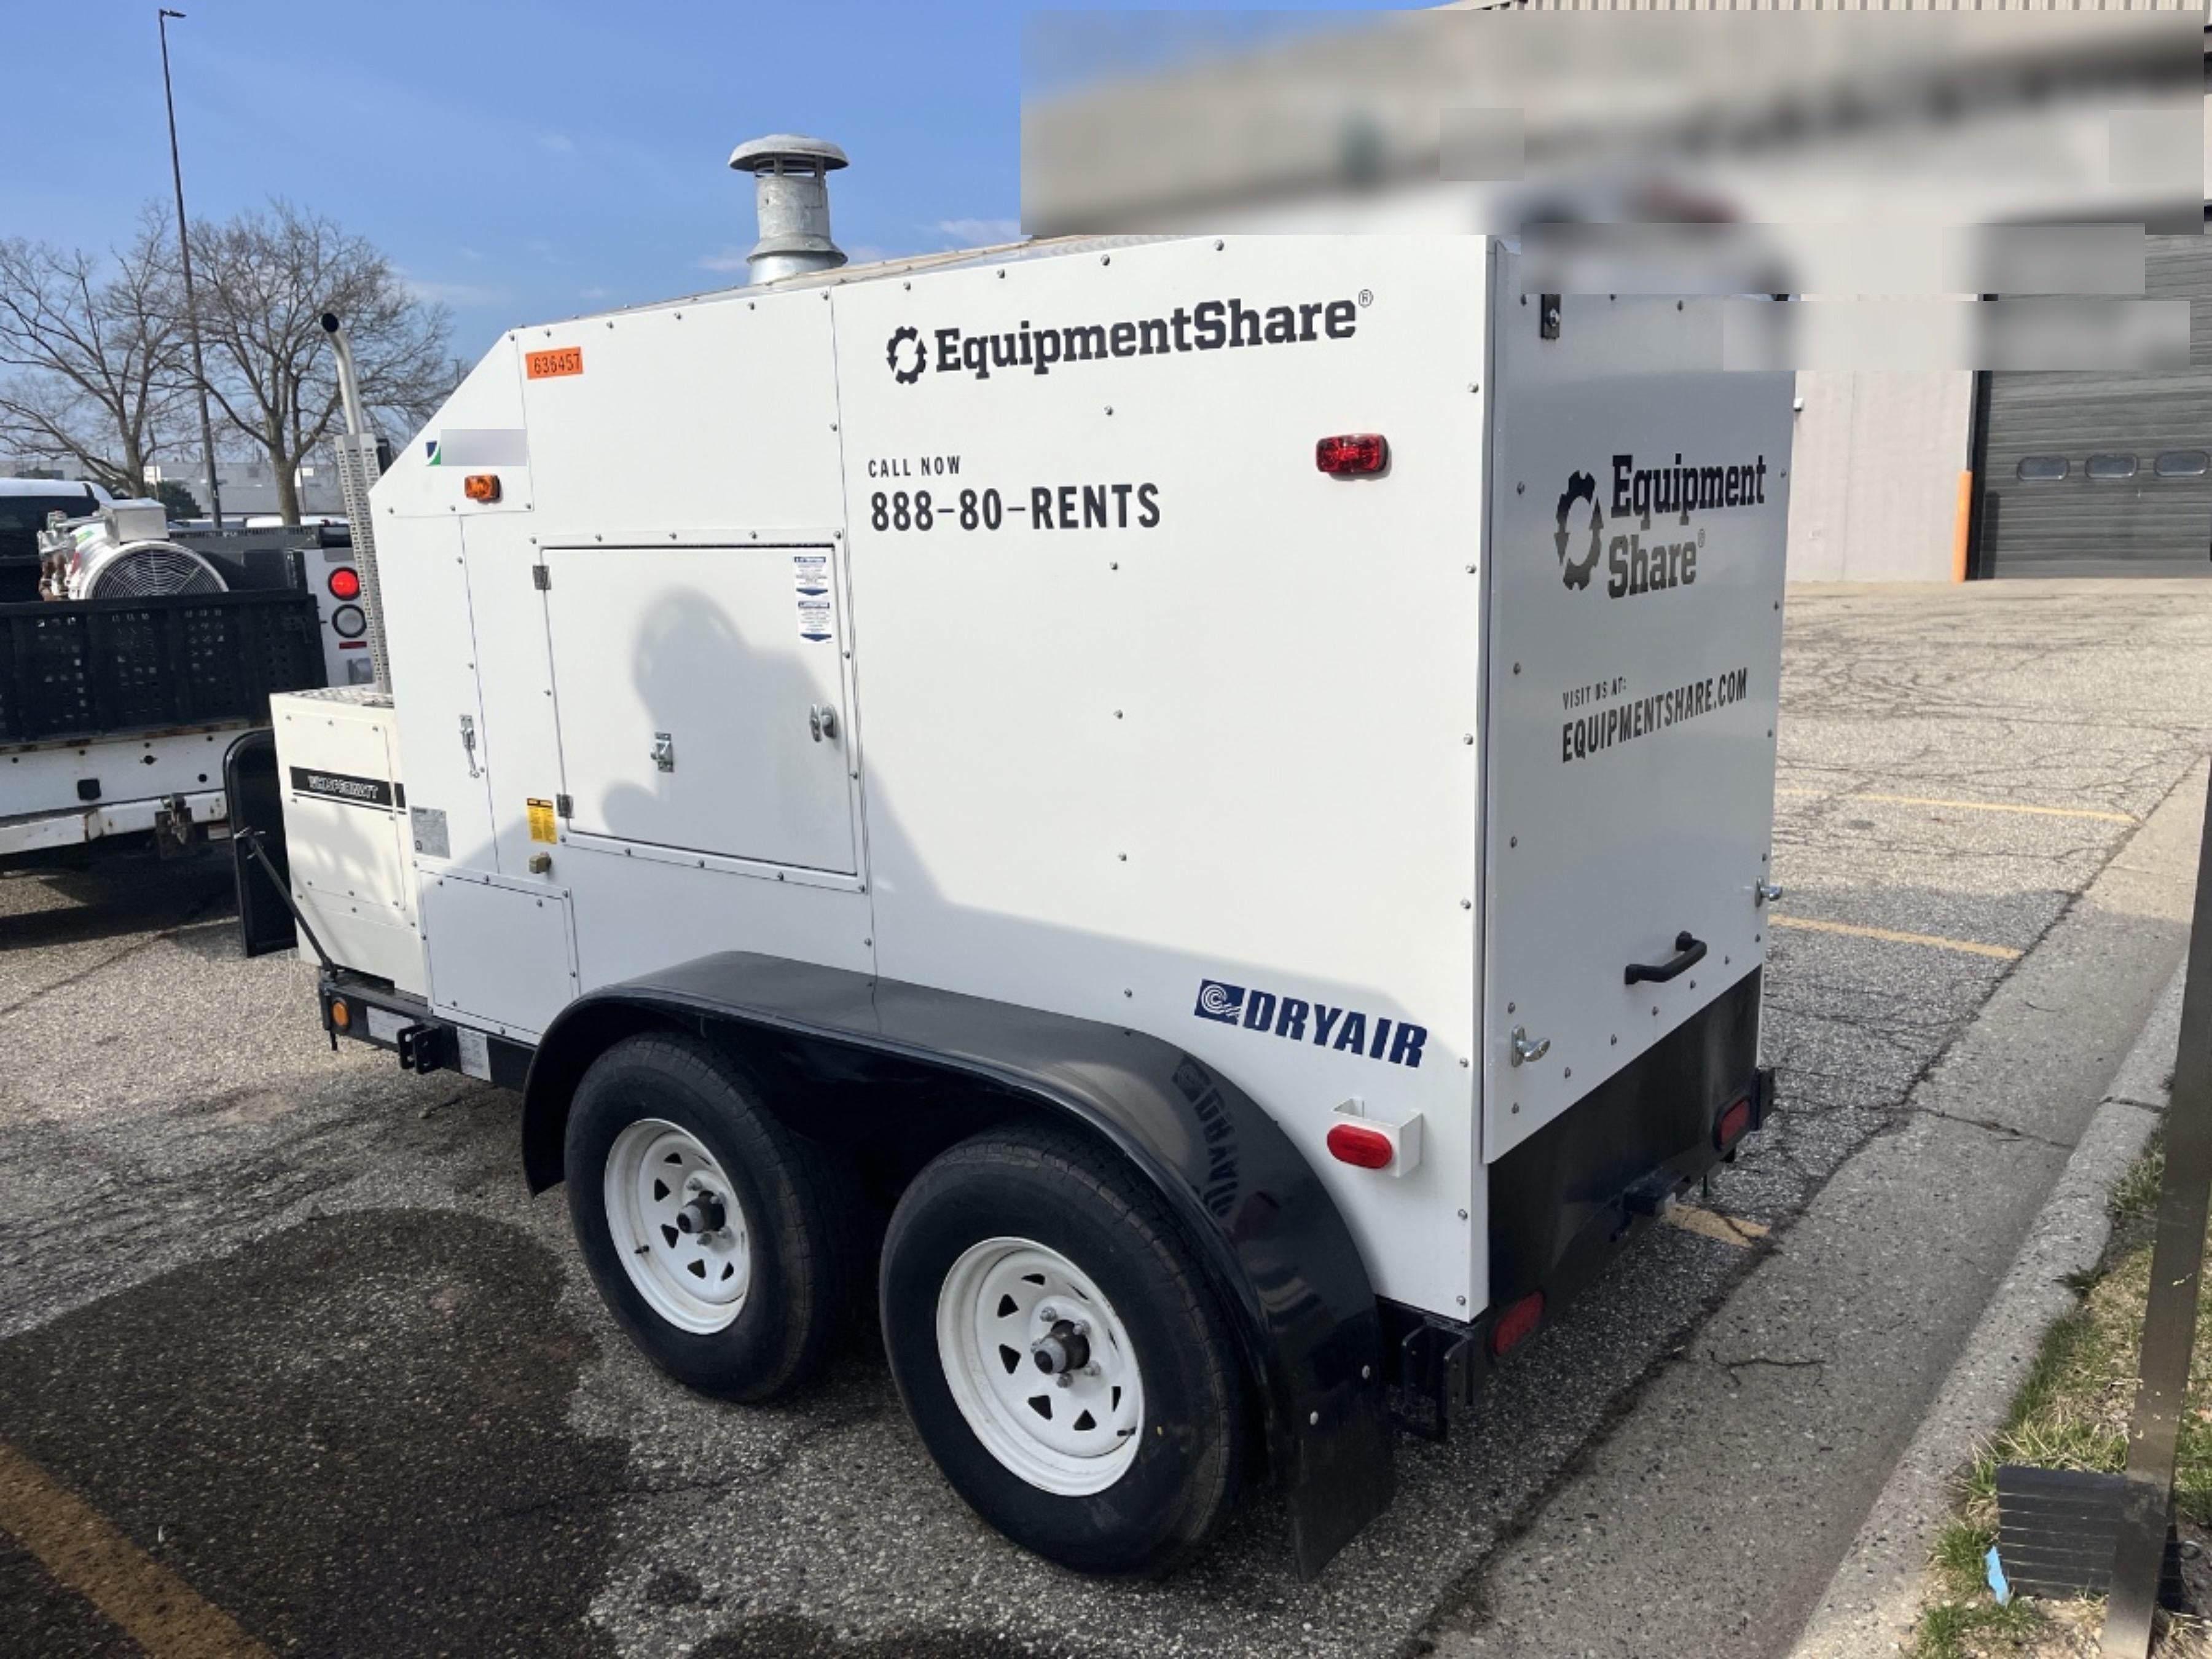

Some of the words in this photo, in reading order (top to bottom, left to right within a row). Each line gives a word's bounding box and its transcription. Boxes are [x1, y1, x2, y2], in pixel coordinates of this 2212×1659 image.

[533, 353, 581, 375] 636457
[868, 458, 911, 478] CALL
[921, 455, 960, 476] NOW
[871, 482, 1161, 531] 888-80-RENTS
[1610, 453, 1767, 531] Equipment
[1562, 685, 1591, 710] VISIT
[1596, 681, 1608, 701] US
[1610, 676, 1626, 696] AT:
[1562, 667, 1748, 763] EQUIPMENTSHARE.COM
[1242, 989, 1428, 1069] DRYAIR
